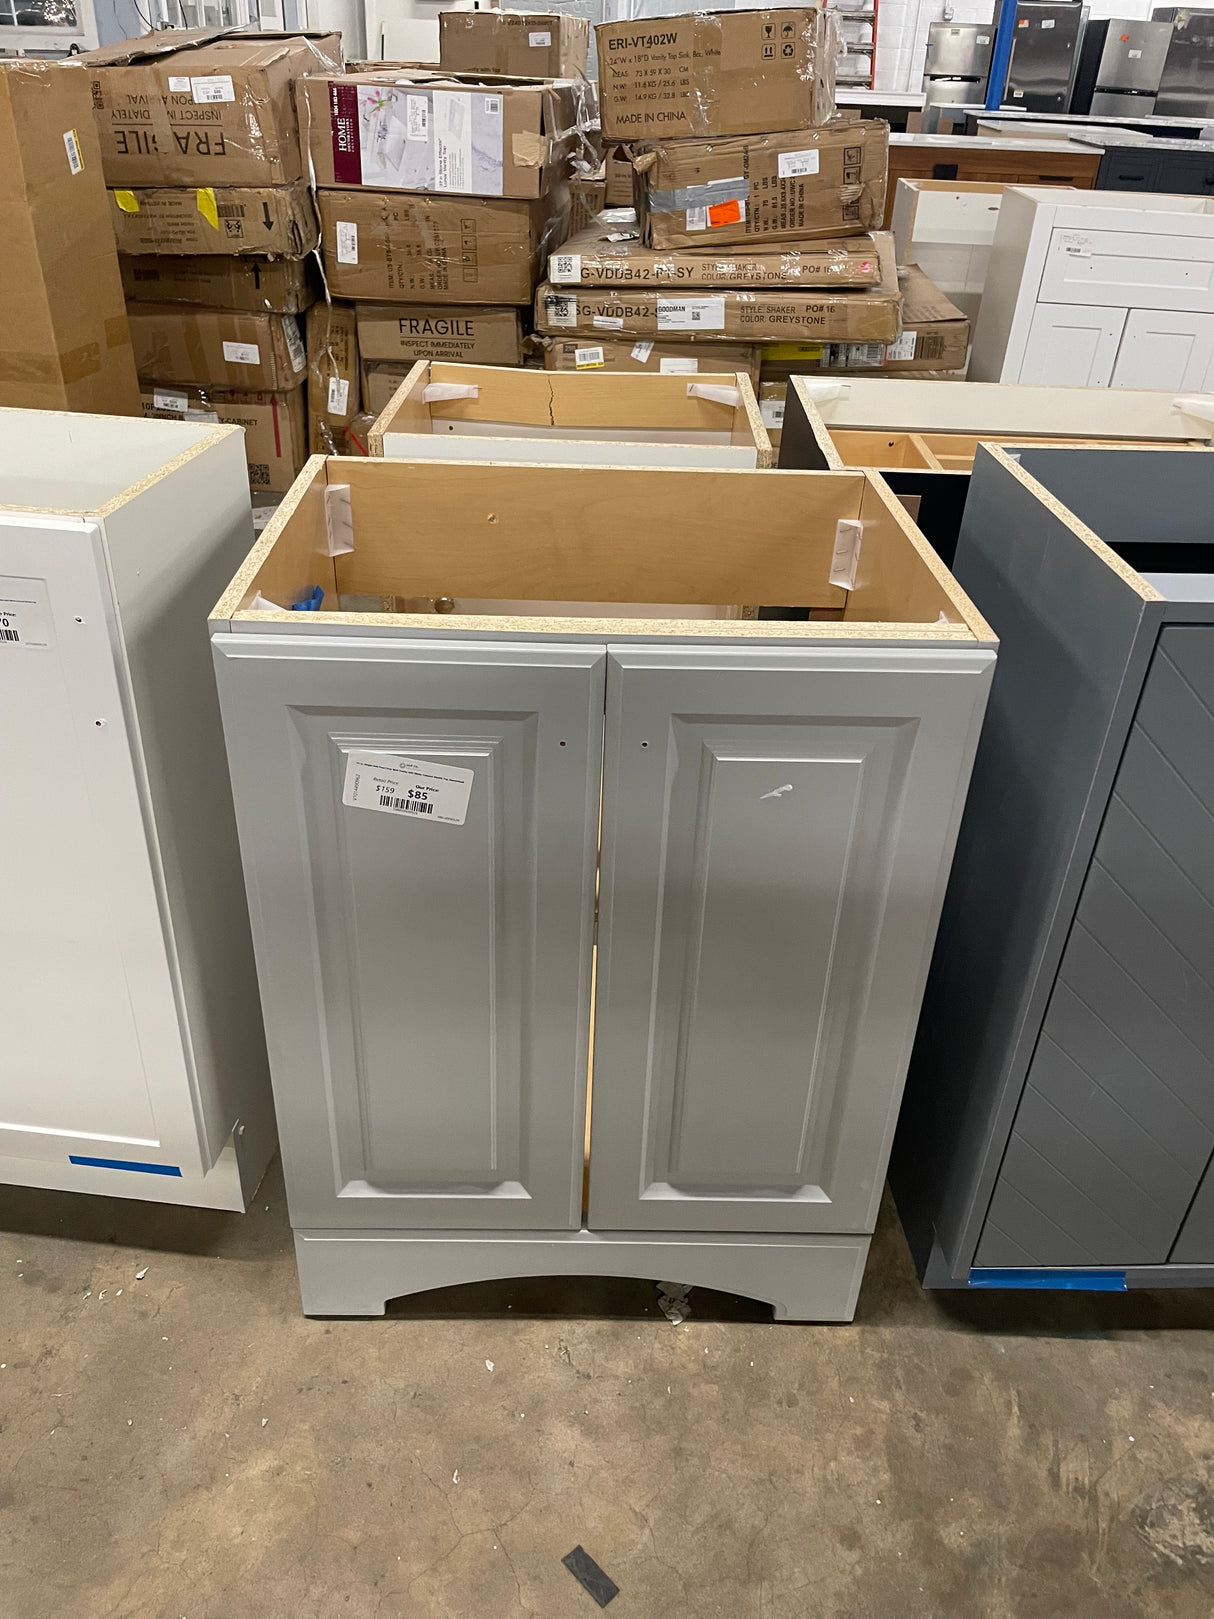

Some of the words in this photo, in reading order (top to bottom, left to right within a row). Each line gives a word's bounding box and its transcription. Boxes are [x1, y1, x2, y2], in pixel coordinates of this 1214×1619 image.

[608, 32, 678, 50] ERI-VT402W
[180, 110, 222, 120] INSPECT
[615, 113, 642, 125] MADE
[645, 112, 655, 123] IN
[656, 111, 687, 122] CHINA
[337, 117, 347, 151] HOME
[766, 305, 796, 314] SHAKER
[805, 304, 824, 313] PO#
[768, 315, 826, 325] GREYSTONE
[398, 318, 475, 336] FRAGILE
[400, 340, 429, 348] INSPECT
[430, 341, 475, 350] IMMEDIATELY
[413, 349, 434, 357] UPON
[435, 350, 464, 358] ARRIVAL
[375, 784, 395, 794] $159
[407, 788, 428, 800] $85
